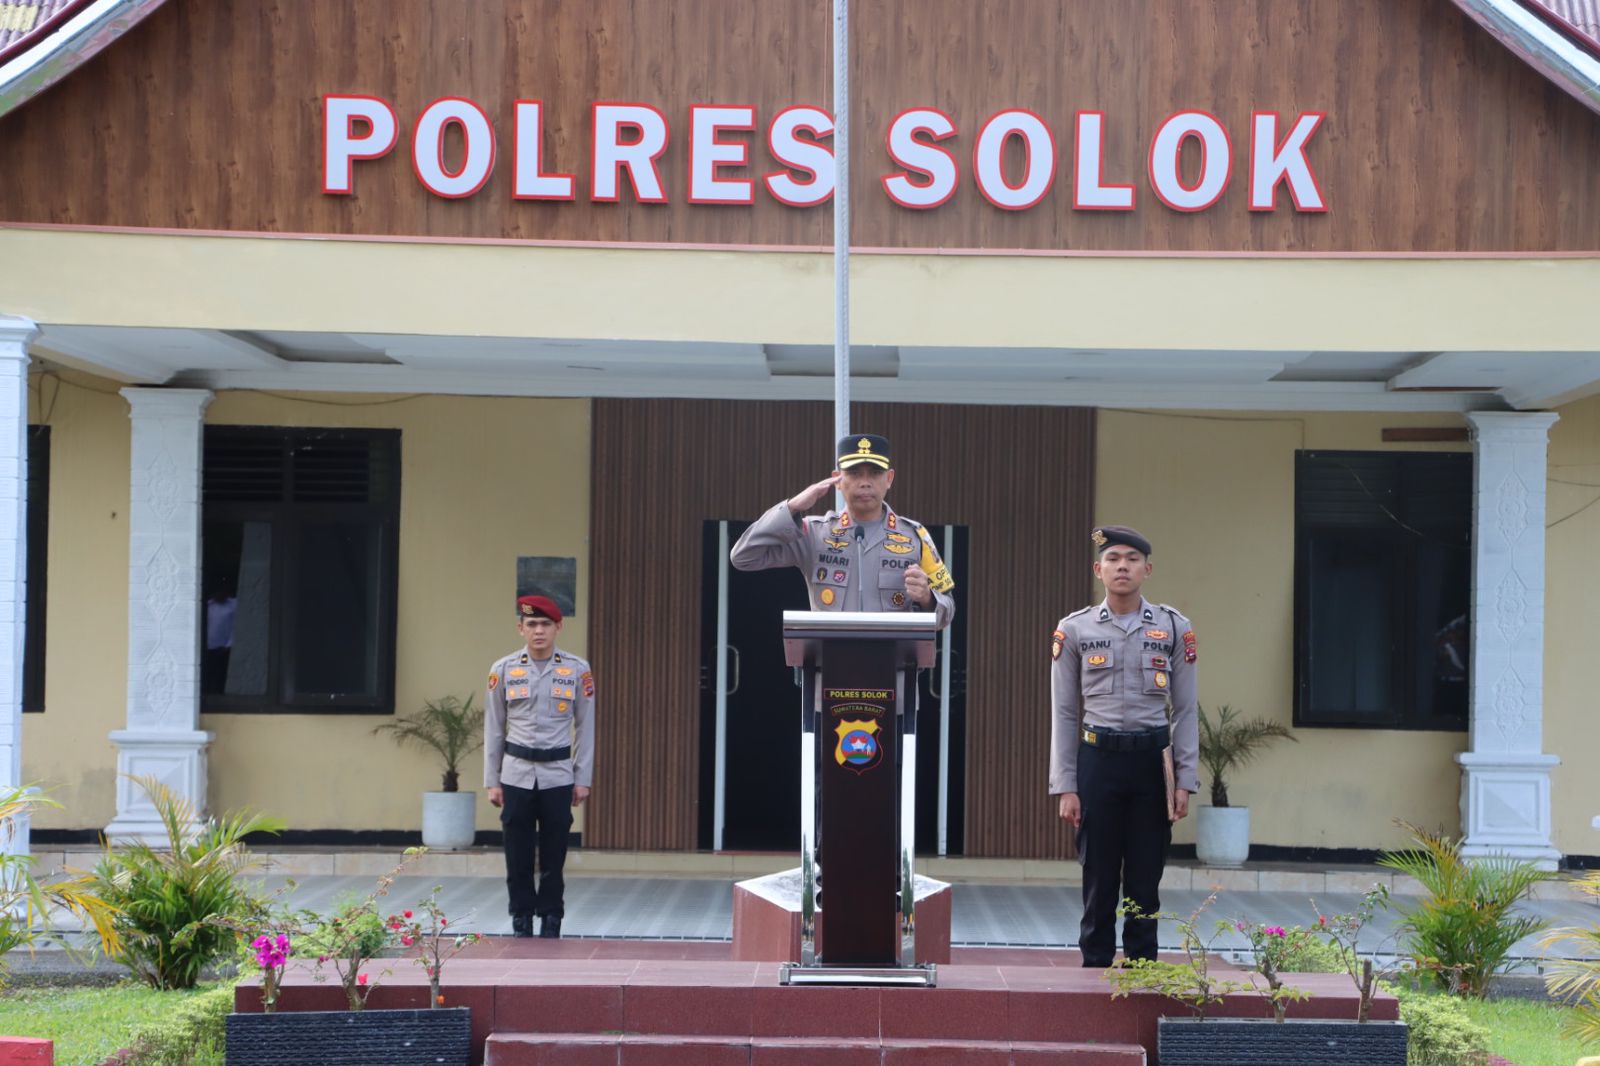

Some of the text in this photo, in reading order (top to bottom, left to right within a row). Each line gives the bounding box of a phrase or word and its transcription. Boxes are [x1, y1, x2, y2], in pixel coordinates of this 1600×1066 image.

[322, 94, 1329, 213] POLRES SOLOK
[818, 553, 850, 567] MUARI
[1080, 640, 1111, 652] DANU
[506, 678, 529, 686] HENDRO
[552, 678, 575, 686] POLRI
[830, 690, 888, 699] POLRES SOLOK
[863, 706, 882, 714] BARAT
